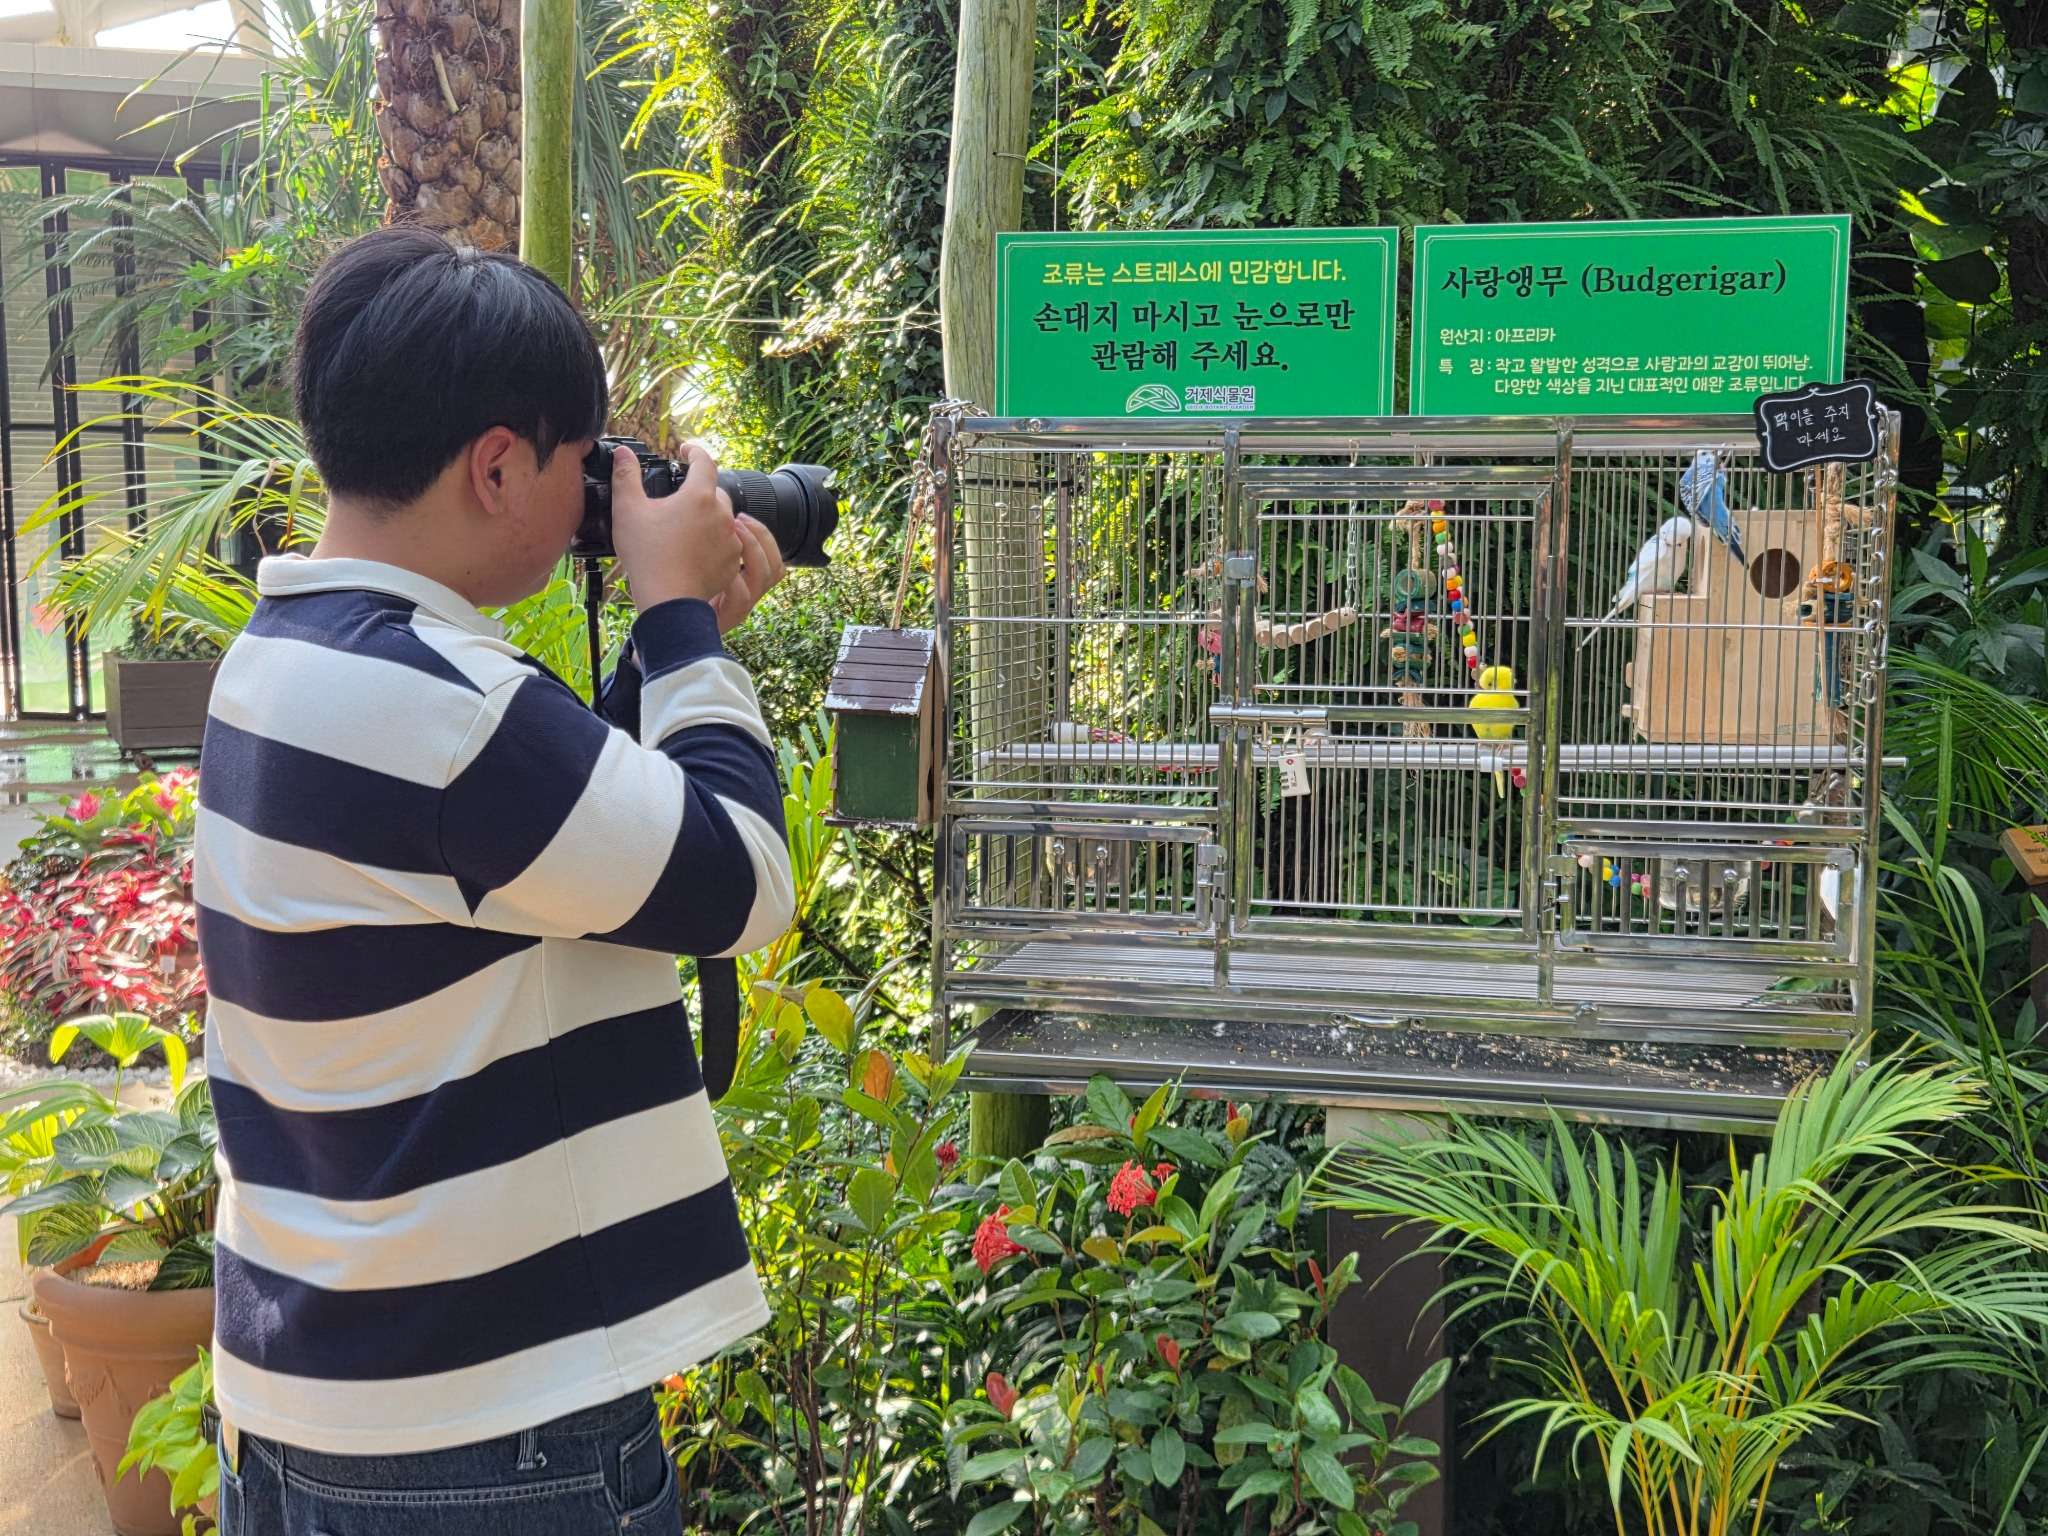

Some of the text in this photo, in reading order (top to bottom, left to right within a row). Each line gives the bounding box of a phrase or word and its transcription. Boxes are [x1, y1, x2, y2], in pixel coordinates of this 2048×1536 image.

[1043, 259, 1347, 286] 조류는 스트레스에 민감합니다.
[1441, 259, 1786, 298] 사랑앵무 (Budgerigar)
[1033, 299, 1355, 333] 손대지 마시고 눈으로만
[1495, 328, 1556, 343] 아프리카
[1091, 340, 1289, 372] 관람해 주세요.
[1495, 358, 1526, 374] 작고
[1530, 357, 1578, 374] 활발한
[1582, 356, 1640, 373] 성격으로
[1644, 356, 1708, 373] 사람과의
[1711, 355, 1759, 371] 교감이
[1763, 354, 1813, 370] 뛰어남.
[1186, 386, 1255, 404] 거제식물원
[1495, 378, 1542, 395] 다양한
[1546, 377, 1591, 395] 색상을
[1596, 377, 1625, 394] 지닌
[1628, 376, 1688, 394] 대표적인
[1692, 376, 1724, 392] 애완
[1774, 403, 1849, 431] 먹이를 주지
[1796, 427, 1847, 447] 마세요
